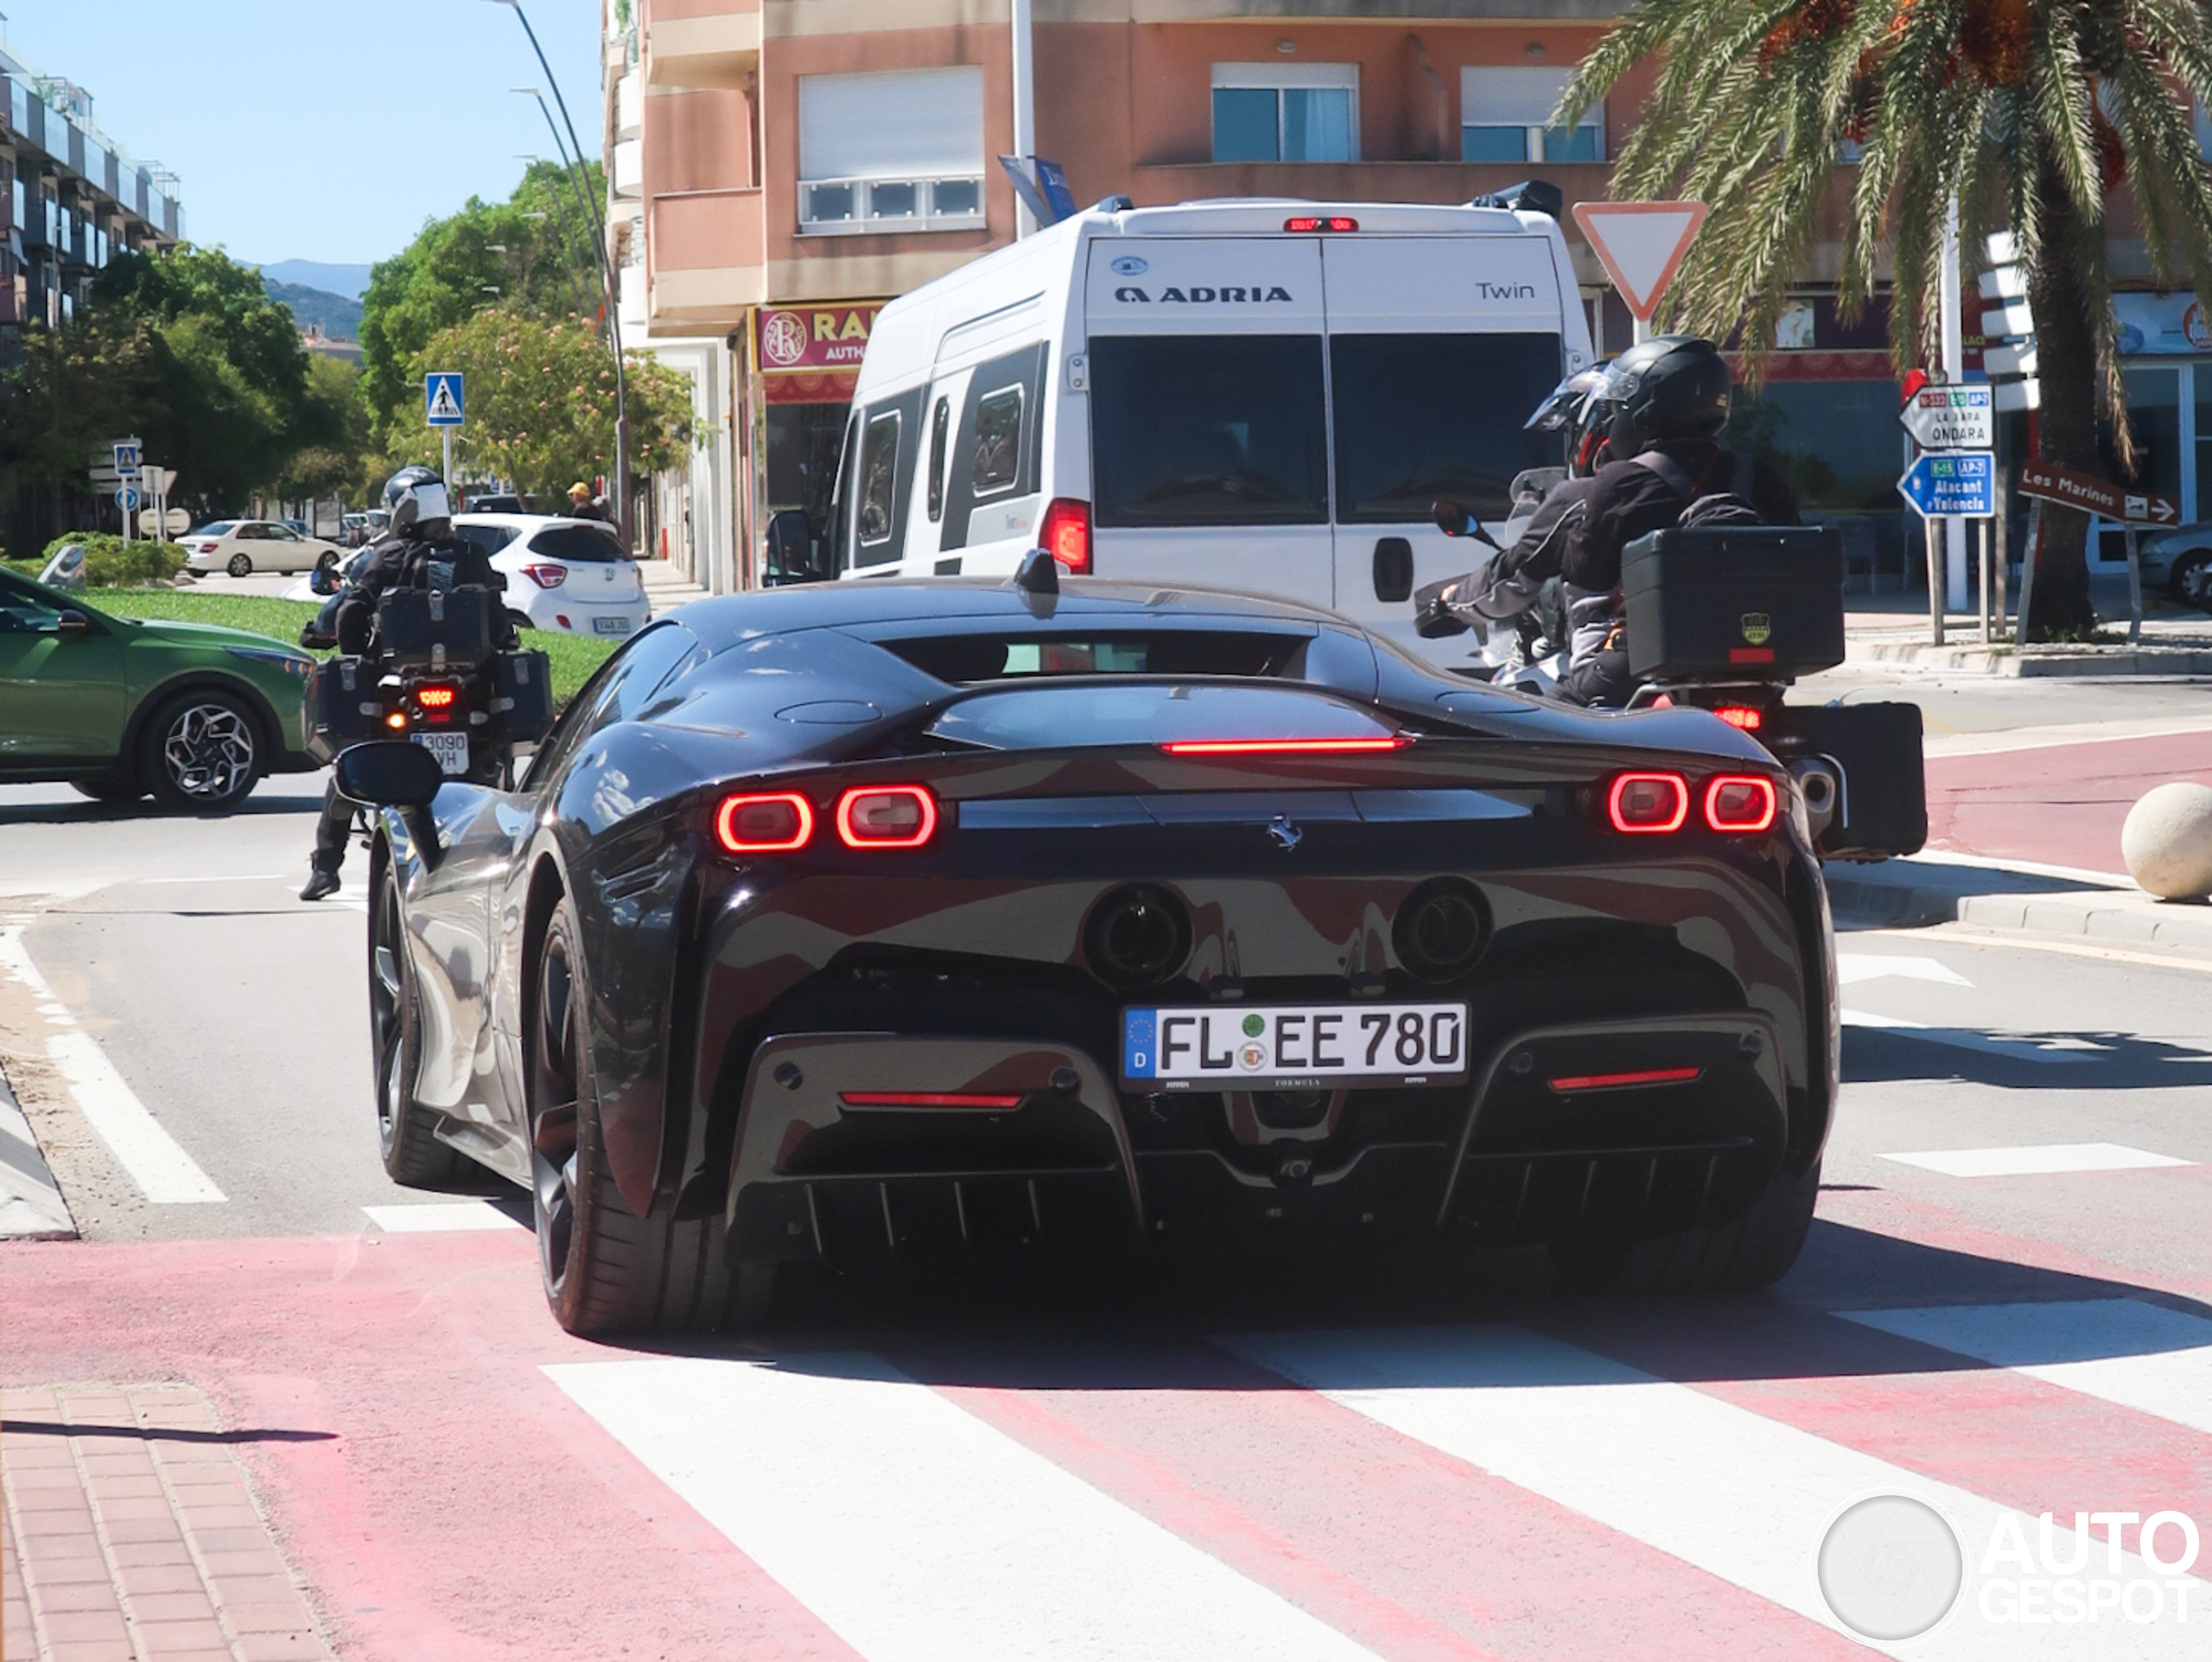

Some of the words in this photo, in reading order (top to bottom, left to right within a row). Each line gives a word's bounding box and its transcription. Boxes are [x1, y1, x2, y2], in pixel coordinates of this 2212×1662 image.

[1160, 287, 1293, 303] ADRIA
[1475, 282, 1535, 300] Twin
[1932, 428, 1986, 441] ONDARA
[1961, 462, 1983, 473] AP-7
[1935, 480, 1982, 494] Alacant
[2023, 468, 2052, 487] Les
[2058, 477, 2115, 506] Marines
[425, 735, 466, 750] 3090
[1134, 1052, 1147, 1068] D
[1161, 1017, 1233, 1070] FL
[1275, 1015, 1344, 1067] EE
[1360, 1012, 1460, 1067] 780
